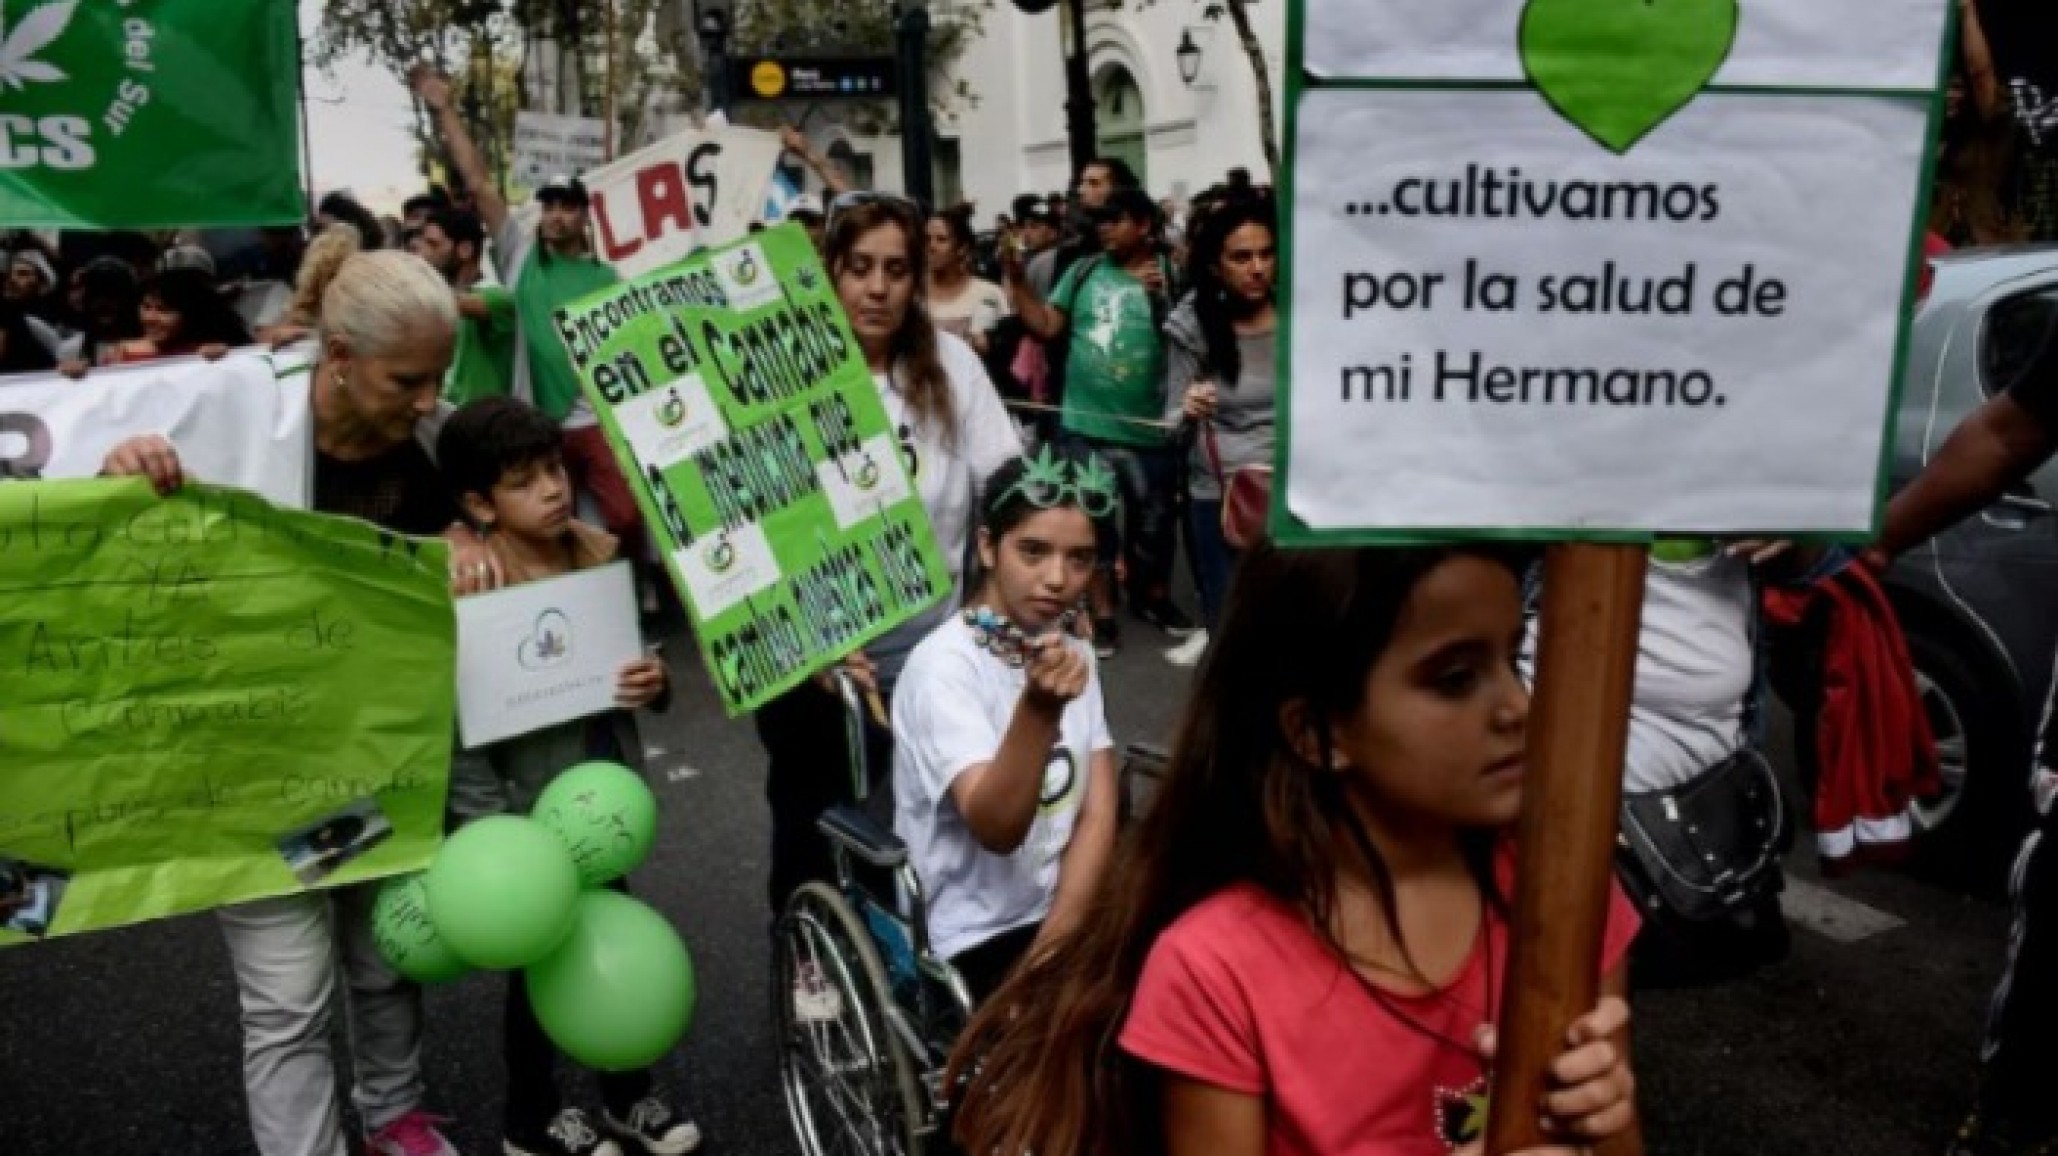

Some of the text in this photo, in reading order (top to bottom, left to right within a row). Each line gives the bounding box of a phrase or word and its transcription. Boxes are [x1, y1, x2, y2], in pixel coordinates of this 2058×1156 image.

[102, 17, 155, 137] del Sur
[591, 140, 724, 261] LAS
[552, 269, 728, 370] Encontramos
[1342, 257, 1787, 319] por la salud de
[592, 282, 847, 406] en el Cannabis
[1341, 349, 1727, 407] mi Hermano.
